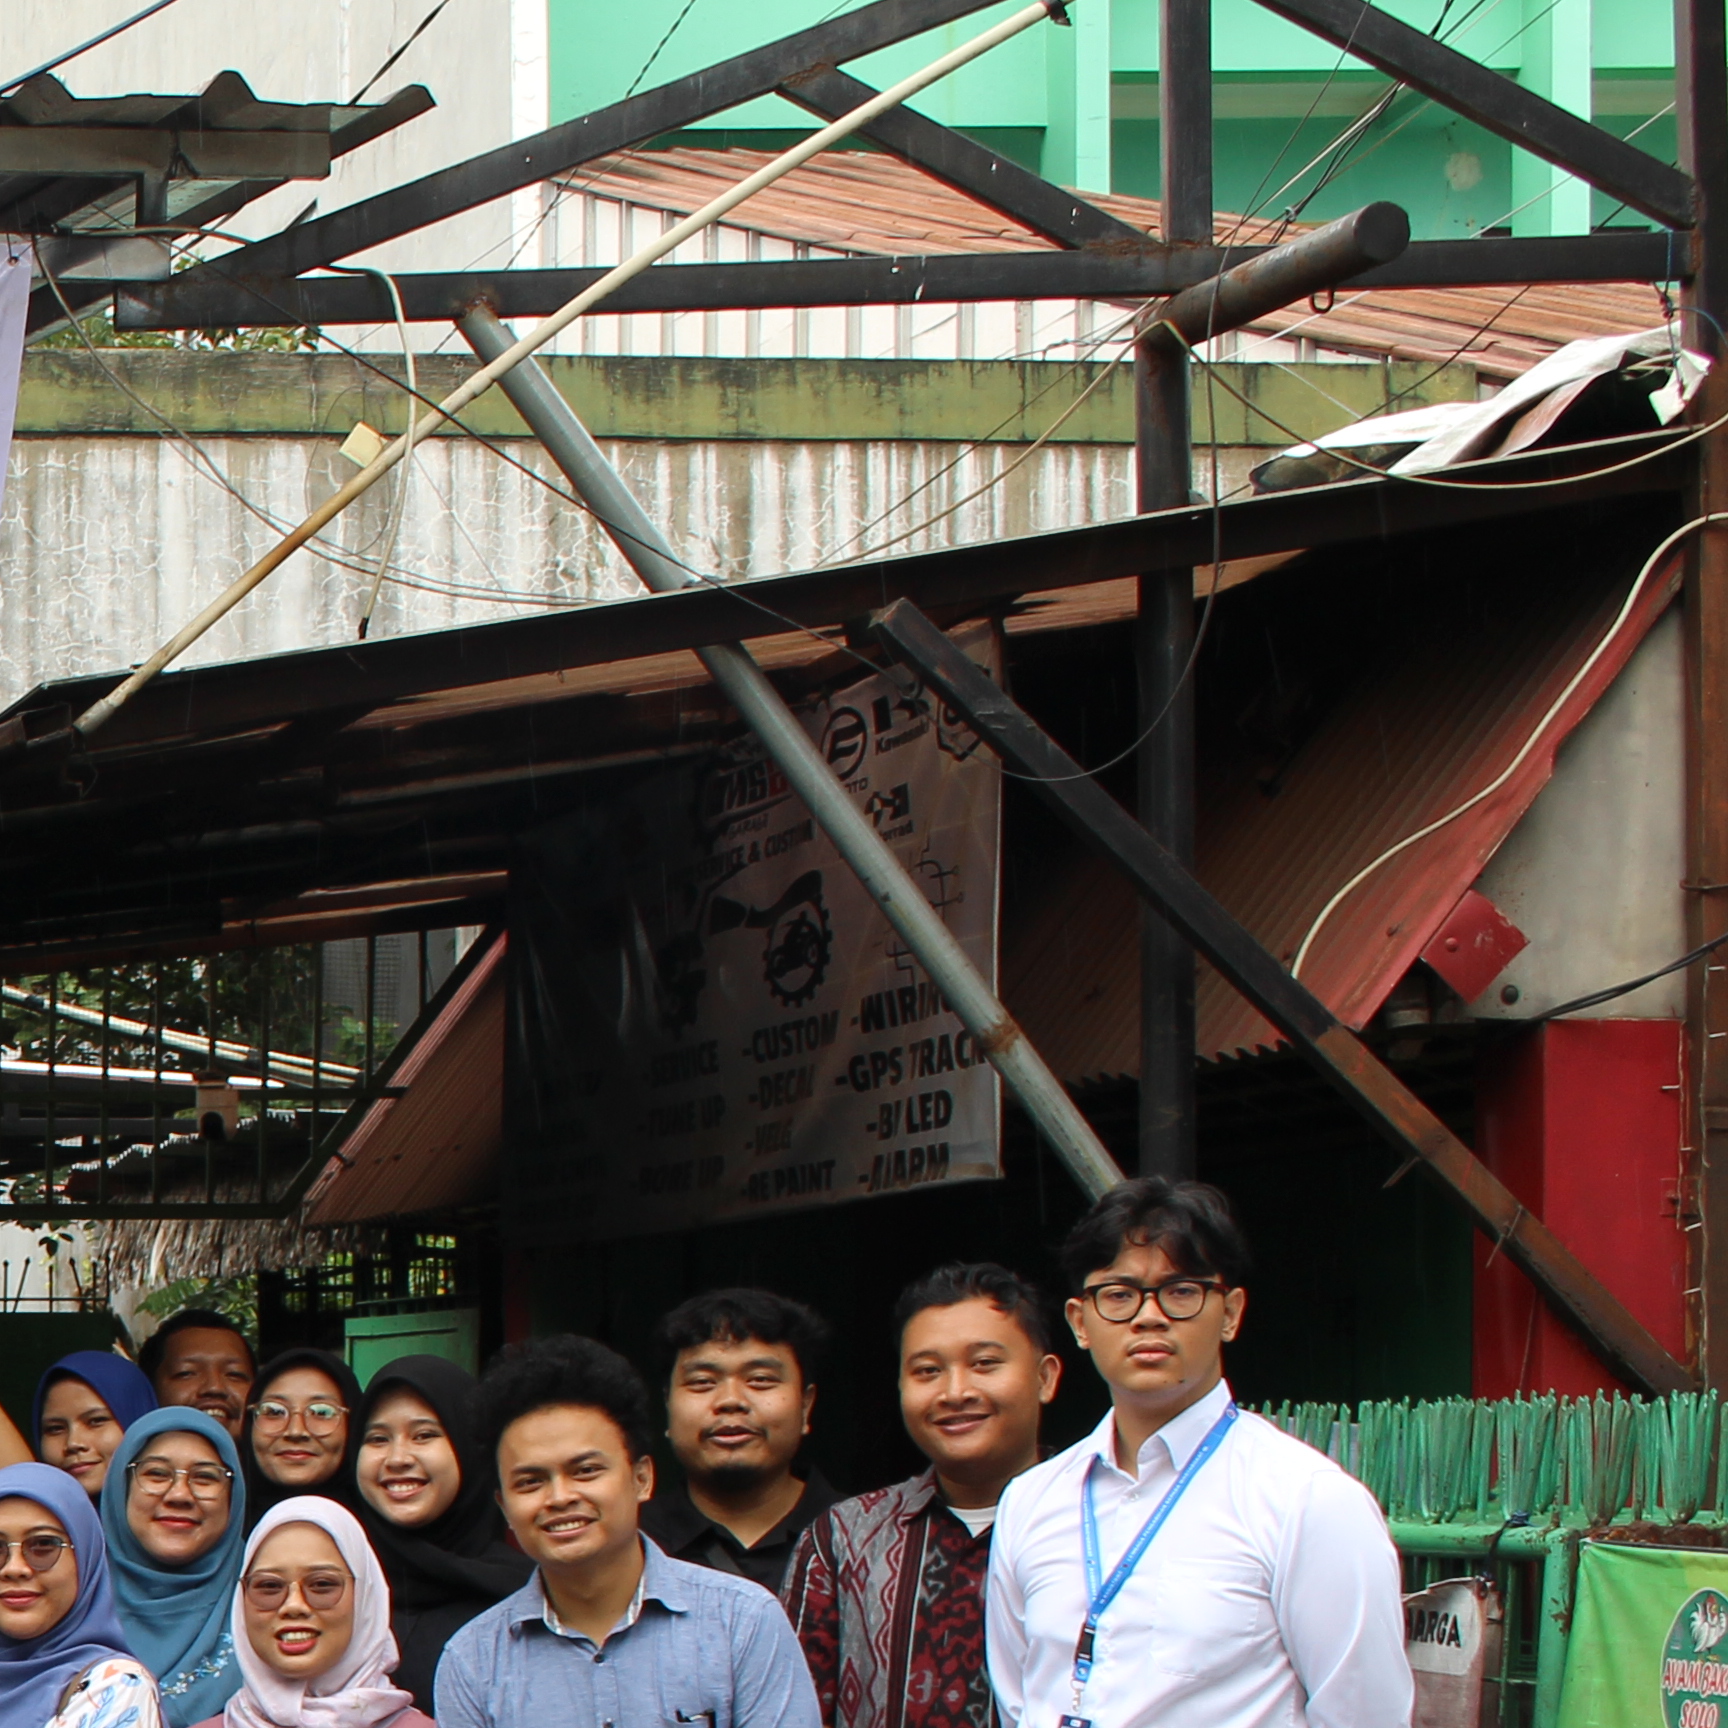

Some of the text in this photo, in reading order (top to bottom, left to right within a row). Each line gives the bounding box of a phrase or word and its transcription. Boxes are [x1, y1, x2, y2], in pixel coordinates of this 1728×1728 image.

[905, 1089, 954, 1135] LED
[1662, 1657, 1728, 1699] AYAM BAK
